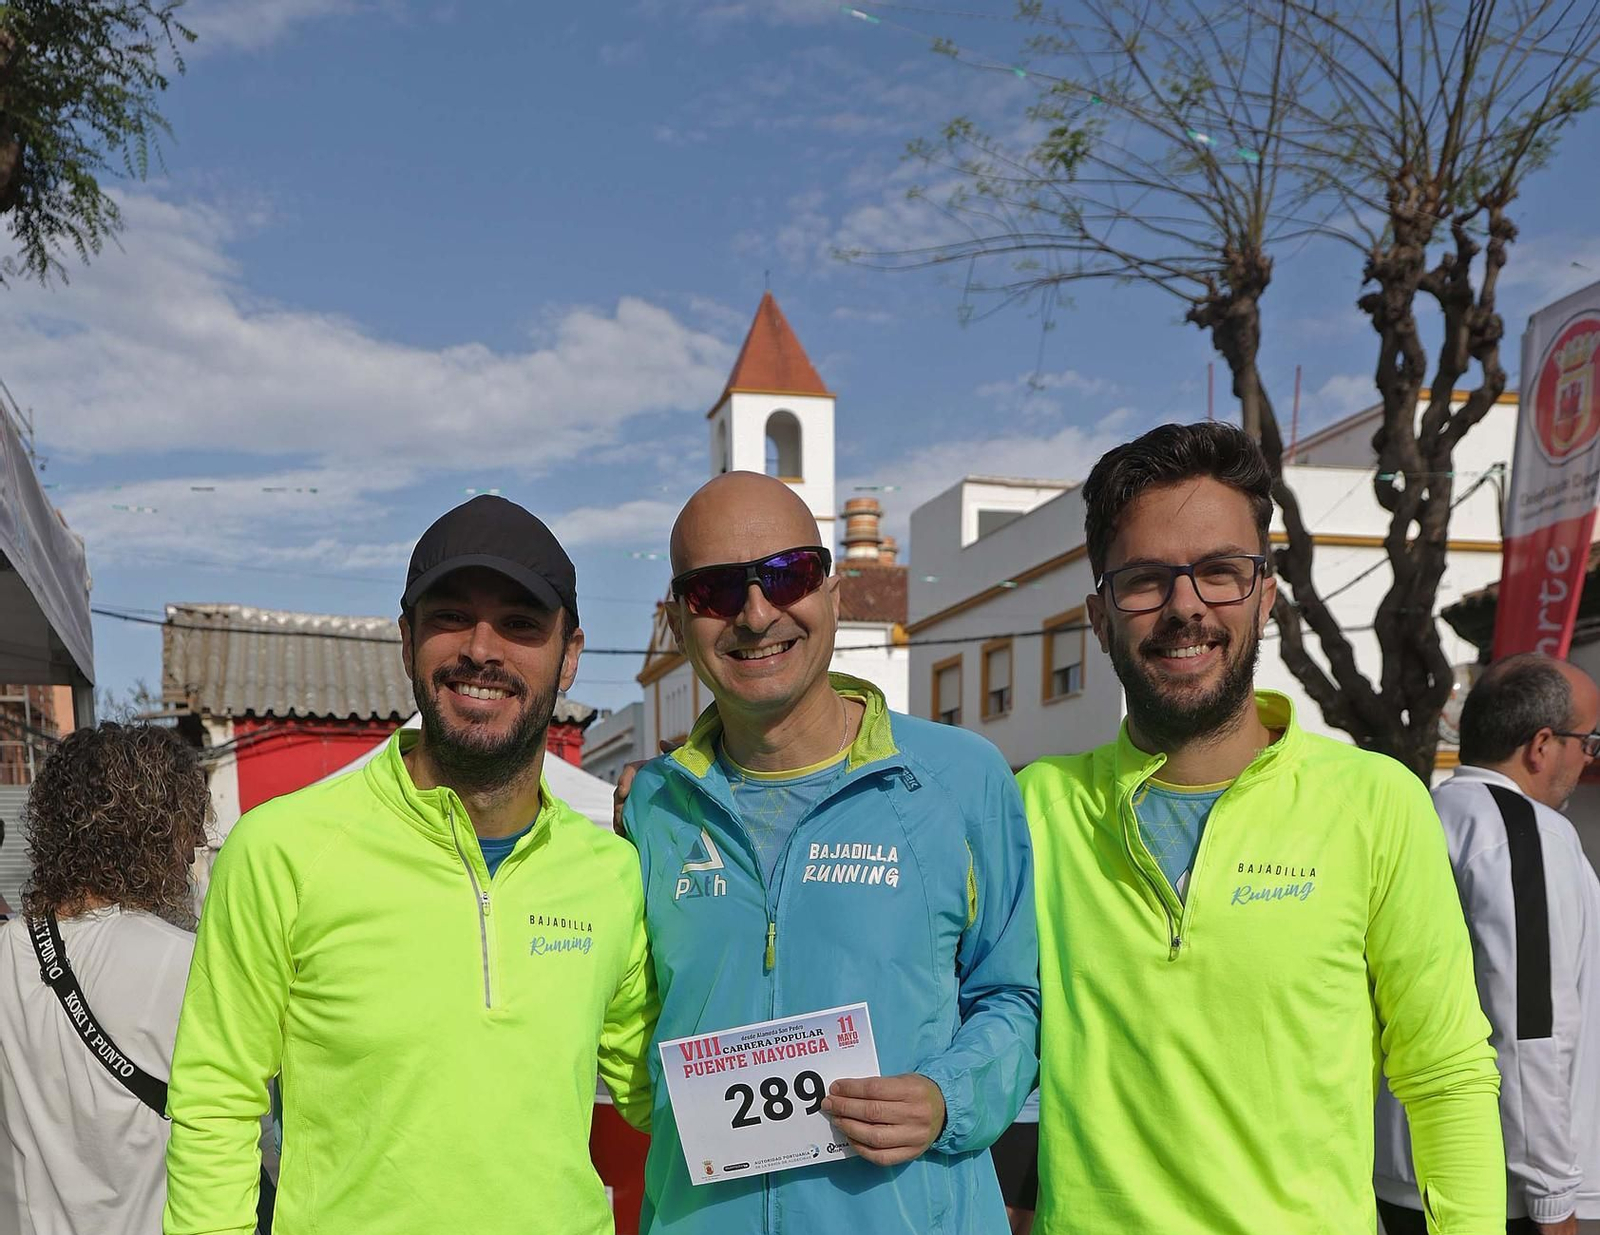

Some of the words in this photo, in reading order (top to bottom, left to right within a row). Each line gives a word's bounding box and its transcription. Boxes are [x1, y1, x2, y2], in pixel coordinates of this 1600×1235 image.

[808, 843, 898, 863] BAJADILLA
[802, 864, 899, 888] RUNNING
[1237, 862, 1316, 877] BAJADILLA
[1230, 881, 1315, 906] Running
[529, 914, 593, 932] BAJADILLA
[530, 936, 593, 956] Running
[39, 937, 64, 980] PUNTO
[64, 989, 89, 1028] KOKI
[84, 1022, 97, 1037] Y
[91, 1033, 135, 1077] PUNTO
[788, 1024, 804, 1033] Pedro
[837, 1014, 854, 1033] 11
[678, 1036, 722, 1062] VIII
[722, 1038, 773, 1055] CARRERA
[774, 1028, 825, 1045] POPULAR
[837, 1031, 858, 1043] MAYO
[683, 1053, 748, 1079] PUENTE
[753, 1038, 830, 1066] MAYORGA
[724, 1070, 827, 1129] 289
